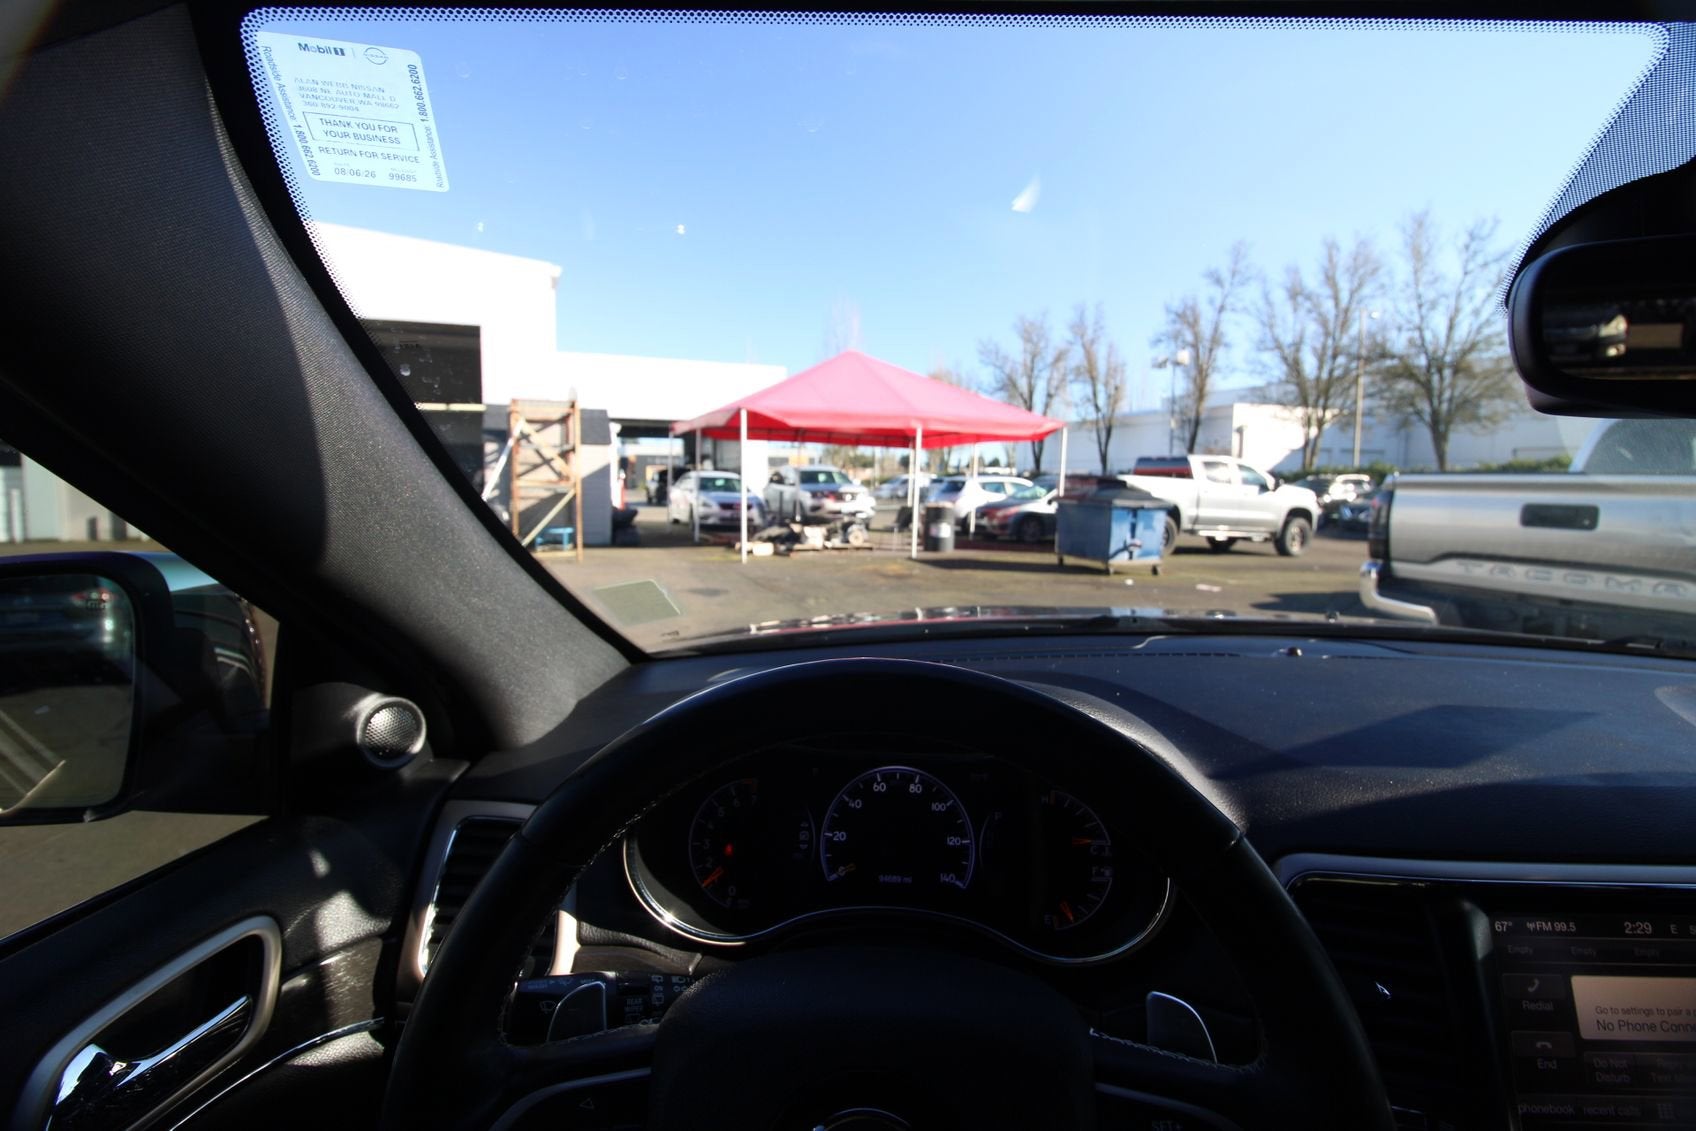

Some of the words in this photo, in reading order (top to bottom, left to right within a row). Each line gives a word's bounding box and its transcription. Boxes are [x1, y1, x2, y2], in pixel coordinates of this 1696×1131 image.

[298, 42, 332, 55] Mobil
[319, 118, 353, 129] THANK
[355, 121, 376, 131] YOU
[378, 124, 398, 133] FOR
[323, 130, 352, 140] YOUR
[352, 132, 401, 145] BUSINESS
[318, 146, 358, 157] RETURN
[359, 150, 379, 159] FOR
[381, 153, 421, 163] SERVICE
[1457, 561, 1689, 598] TACOMA
[873, 782, 887, 792] 60
[909, 783, 923, 794] 80
[848, 799, 863, 809] 40
[931, 802, 947, 812] 100
[832, 831, 847, 841] 20
[946, 836, 962, 846] 120
[940, 873, 956, 883] 140
[1536, 922, 1552, 932] FM
[1553, 922, 1577, 932] 99.5
[1623, 922, 1653, 935] 2:29
[1522, 1001, 1554, 1011] Redial
[1595, 1005, 1608, 1015] Go
[1610, 1006, 1619, 1015] to
[1621, 1007, 1655, 1018] settings
[1656, 1008, 1665, 1016] to
[1667, 1007, 1683, 1018] pair
[1597, 1019, 1615, 1032] No
[1618, 1020, 1657, 1033] Phone
[1536, 1058, 1557, 1070] End
[1518, 1103, 1576, 1116] phonebook
[1584, 1105, 1616, 1116] recent
